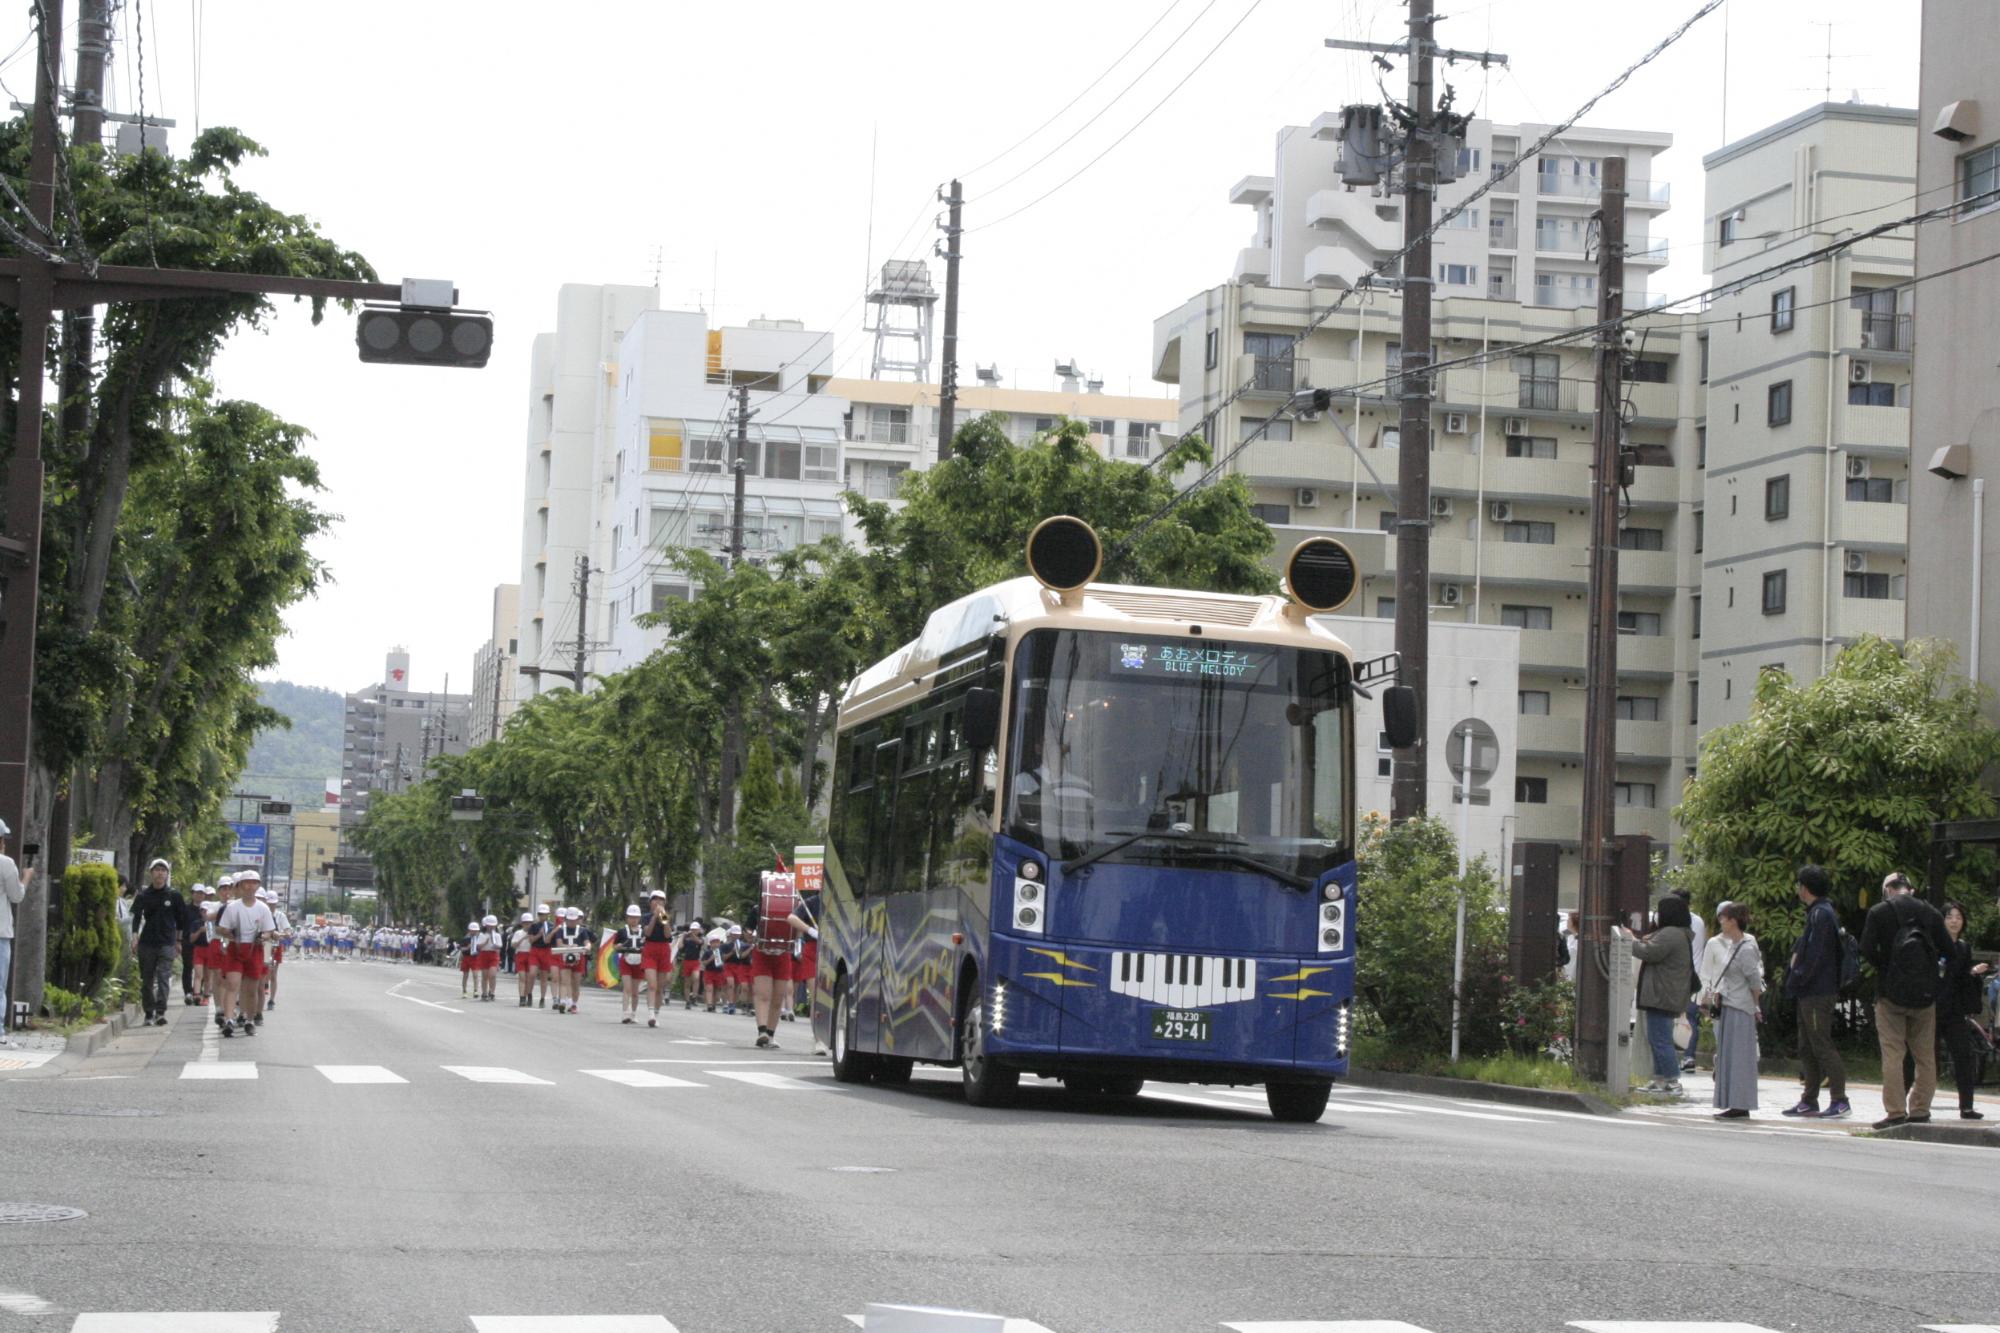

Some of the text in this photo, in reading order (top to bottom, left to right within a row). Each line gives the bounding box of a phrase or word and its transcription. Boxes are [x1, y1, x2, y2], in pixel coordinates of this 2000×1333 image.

[1160, 647, 1249, 664] あおメロディ
[1165, 661, 1245, 676] BLUE MELODY
[1184, 1012, 1200, 1022] 230
[1164, 1021, 1207, 1040] 29-41
